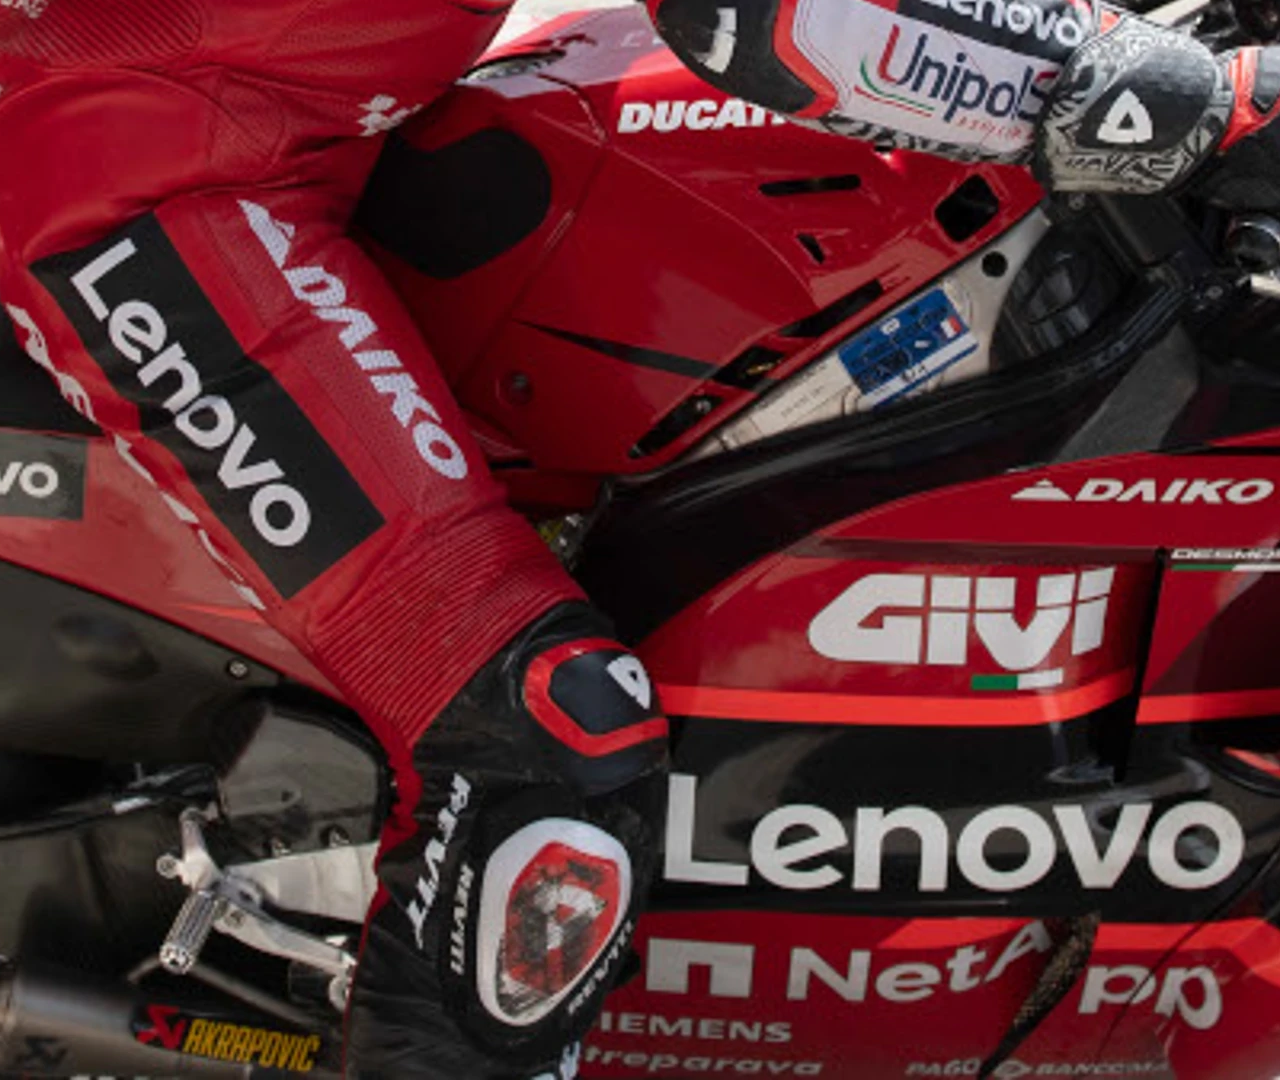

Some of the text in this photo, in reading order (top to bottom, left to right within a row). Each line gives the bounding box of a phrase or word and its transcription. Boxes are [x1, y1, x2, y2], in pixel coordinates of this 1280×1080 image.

[69, 236, 311, 548] Lenovo
[1074, 478, 1277, 504] DAIKO
[807, 566, 1117, 671] GIVI
[663, 773, 1247, 893] Lenovo
